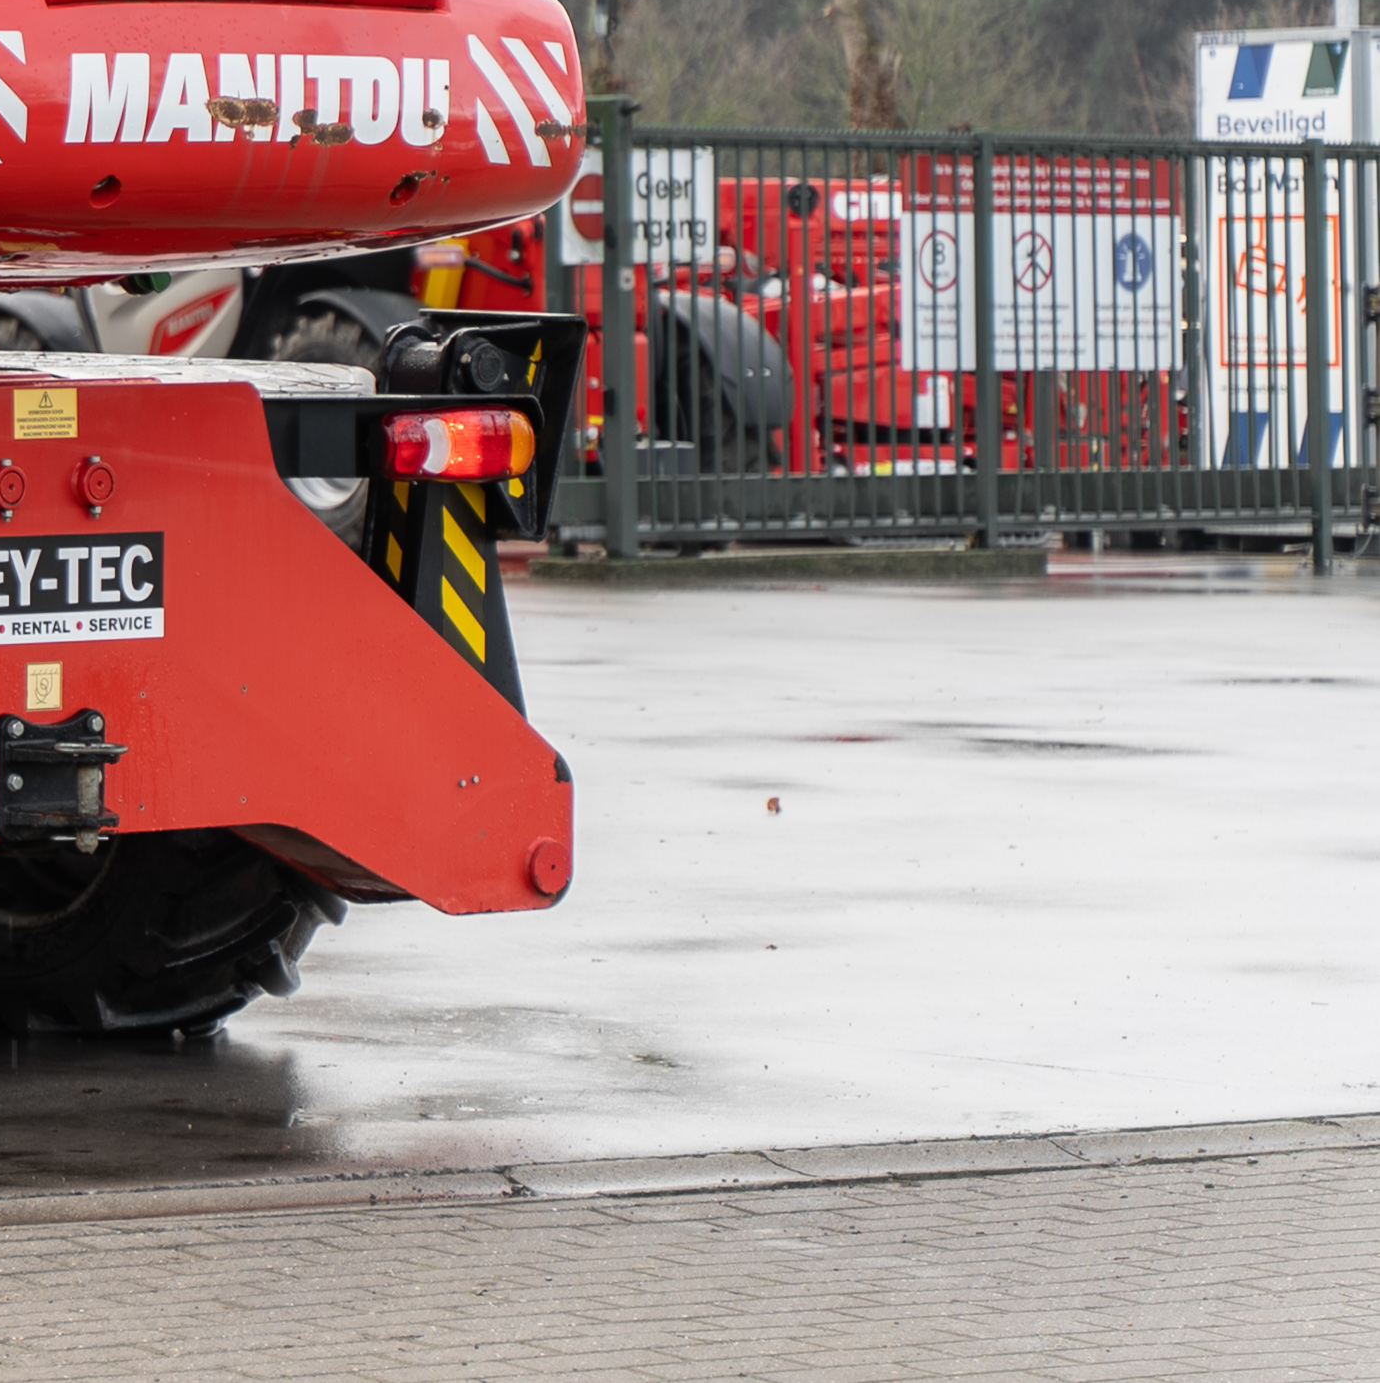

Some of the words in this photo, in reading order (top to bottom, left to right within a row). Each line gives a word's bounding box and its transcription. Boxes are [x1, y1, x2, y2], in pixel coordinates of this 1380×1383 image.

[64, 52, 450, 147] MANITOU
[1216, 108, 1326, 139] Beveiligd
[11, 619, 71, 636] RENTAL
[88, 615, 153, 633] SERVICE
